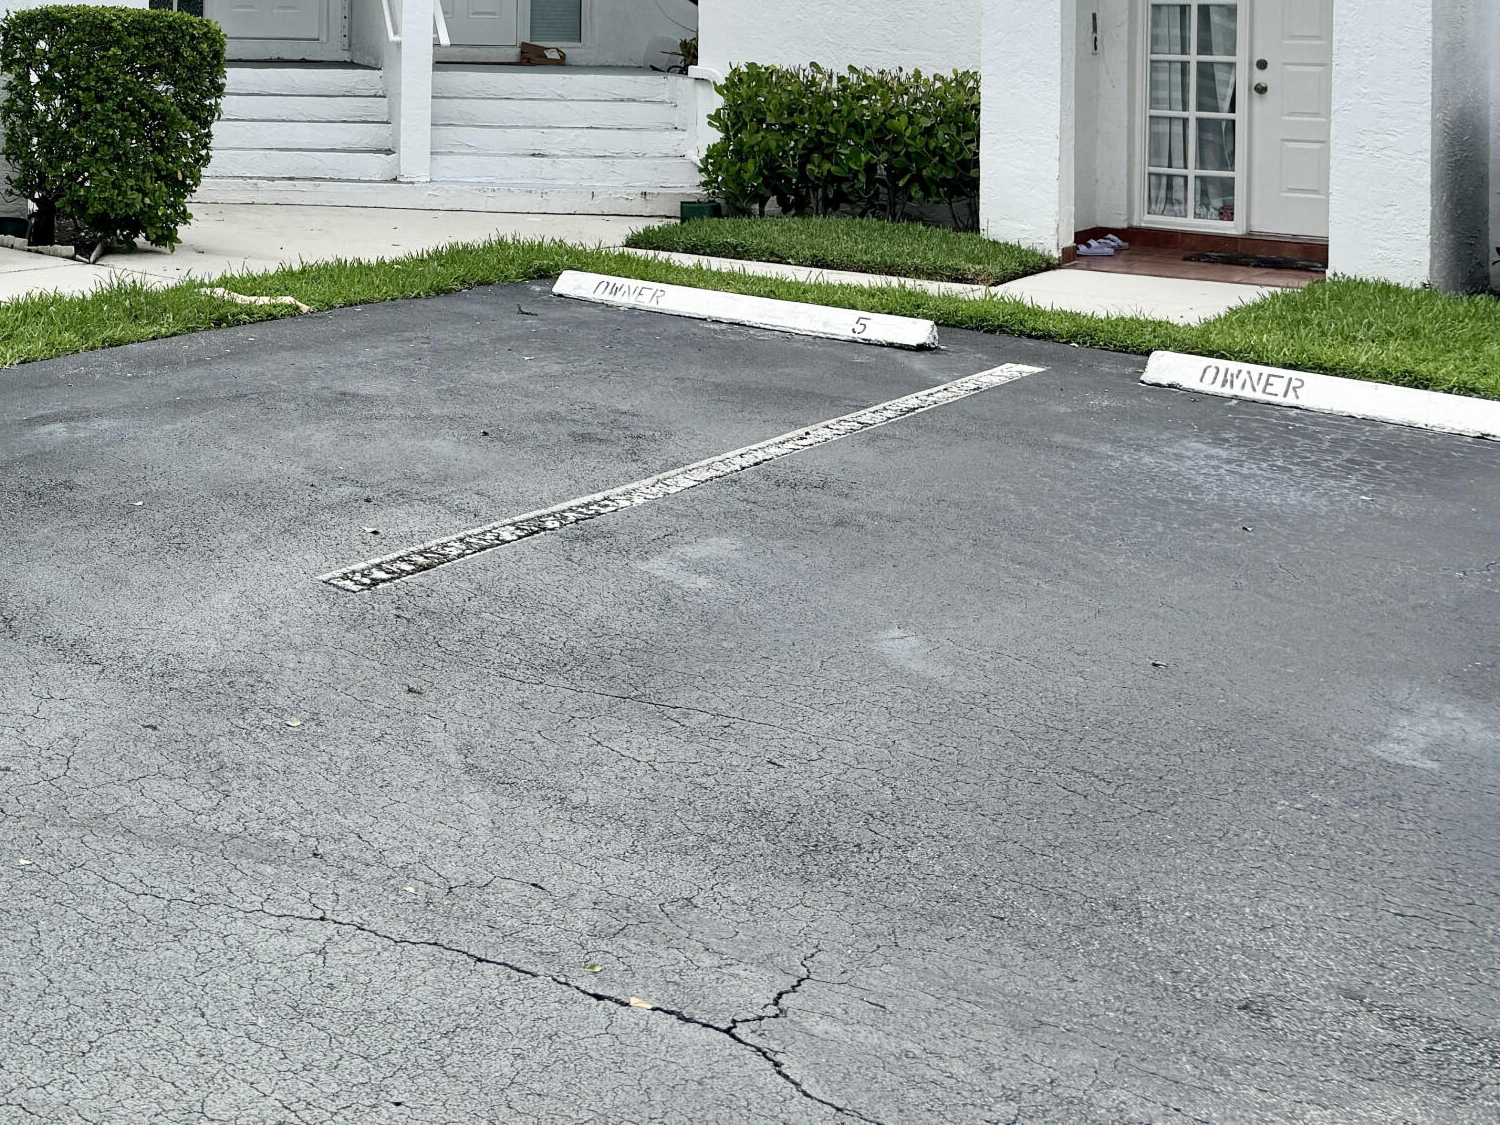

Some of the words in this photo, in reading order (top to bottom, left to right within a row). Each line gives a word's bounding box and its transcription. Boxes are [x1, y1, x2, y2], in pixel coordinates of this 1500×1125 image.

[593, 280, 666, 306] OWNER
[851, 316, 871, 335] 5
[1199, 364, 1306, 400] OWNER
